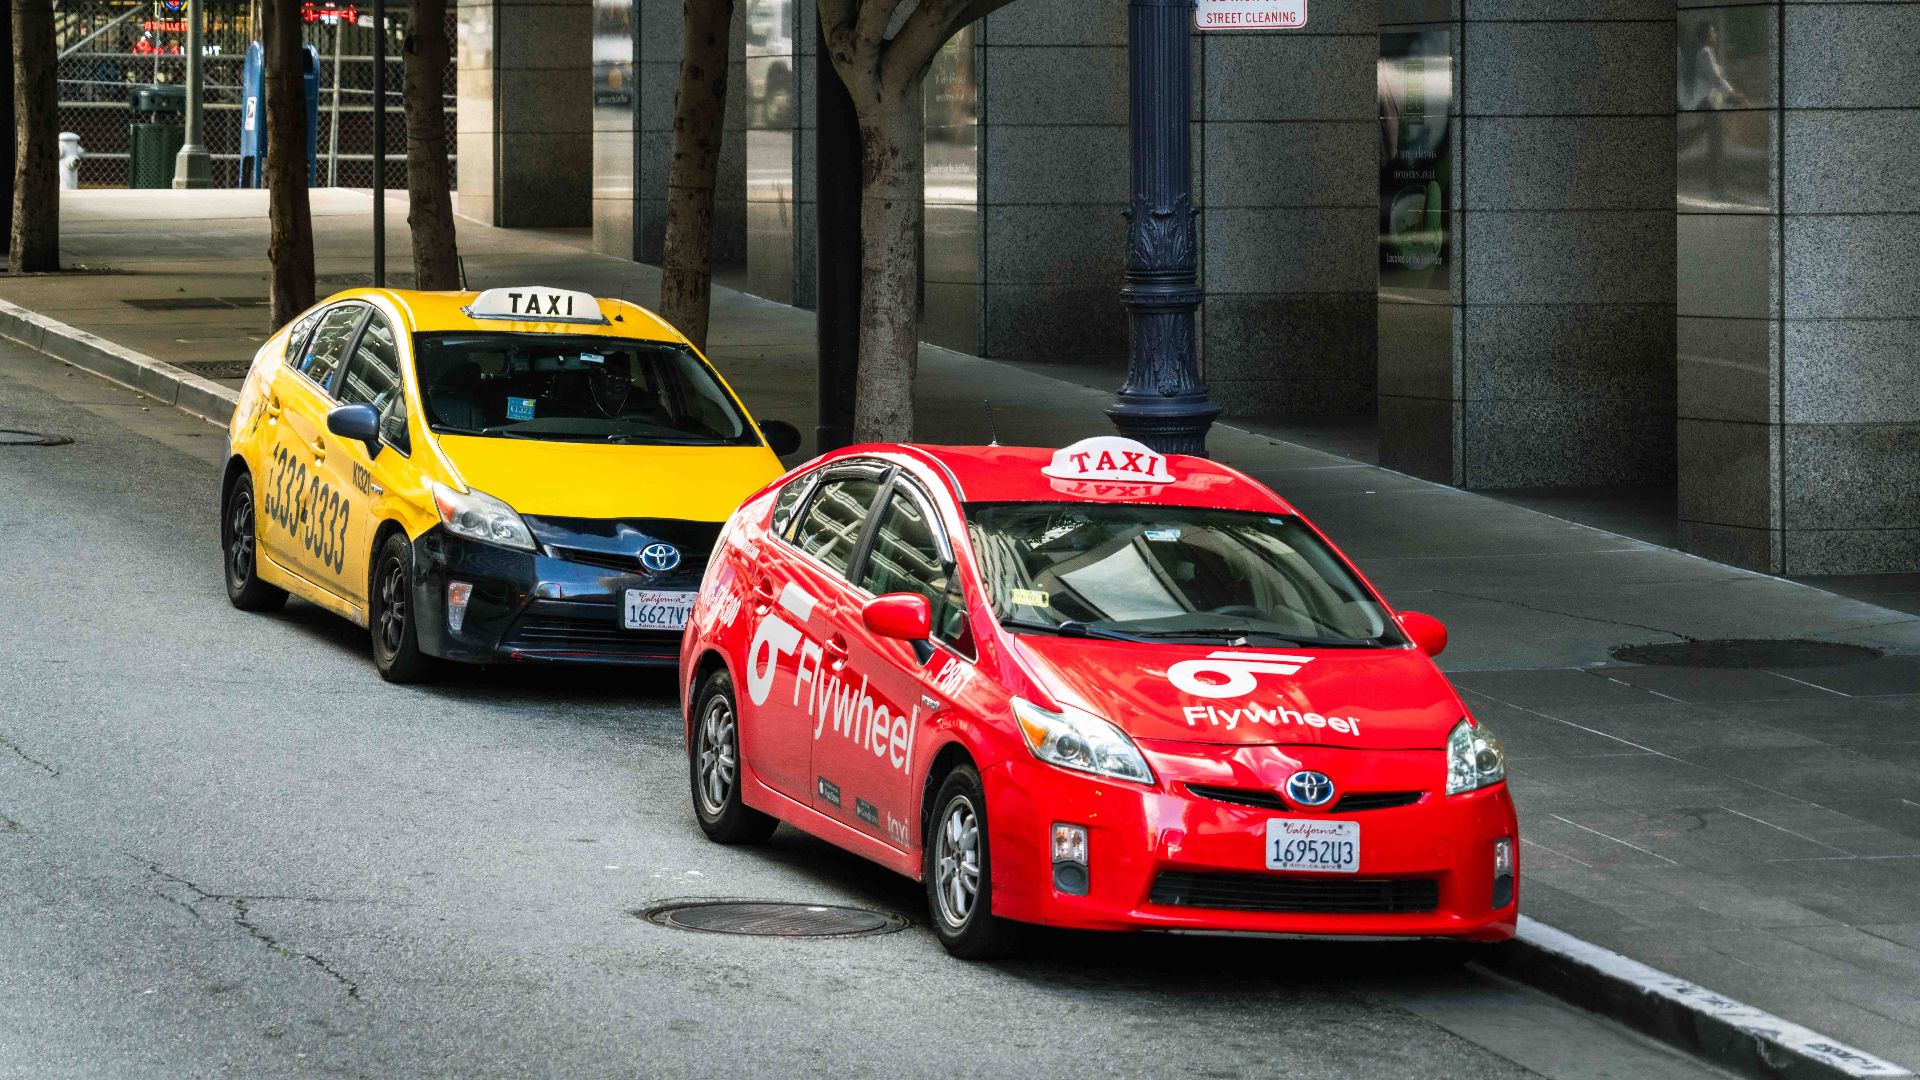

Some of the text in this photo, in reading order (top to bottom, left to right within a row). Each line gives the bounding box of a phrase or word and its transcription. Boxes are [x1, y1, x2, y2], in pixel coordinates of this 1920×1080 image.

[1206, 12, 1296, 23] STREET CLEANING
[508, 292, 573, 315] TAXI
[1070, 450, 1158, 476] TAXI
[352, 460, 371, 496] K1321
[640, 592, 685, 605] California
[793, 638, 919, 775] Flywheel
[1182, 705, 1360, 736] Flywheel
[1286, 822, 1341, 838] California
[1273, 838, 1353, 864] 16952U3
